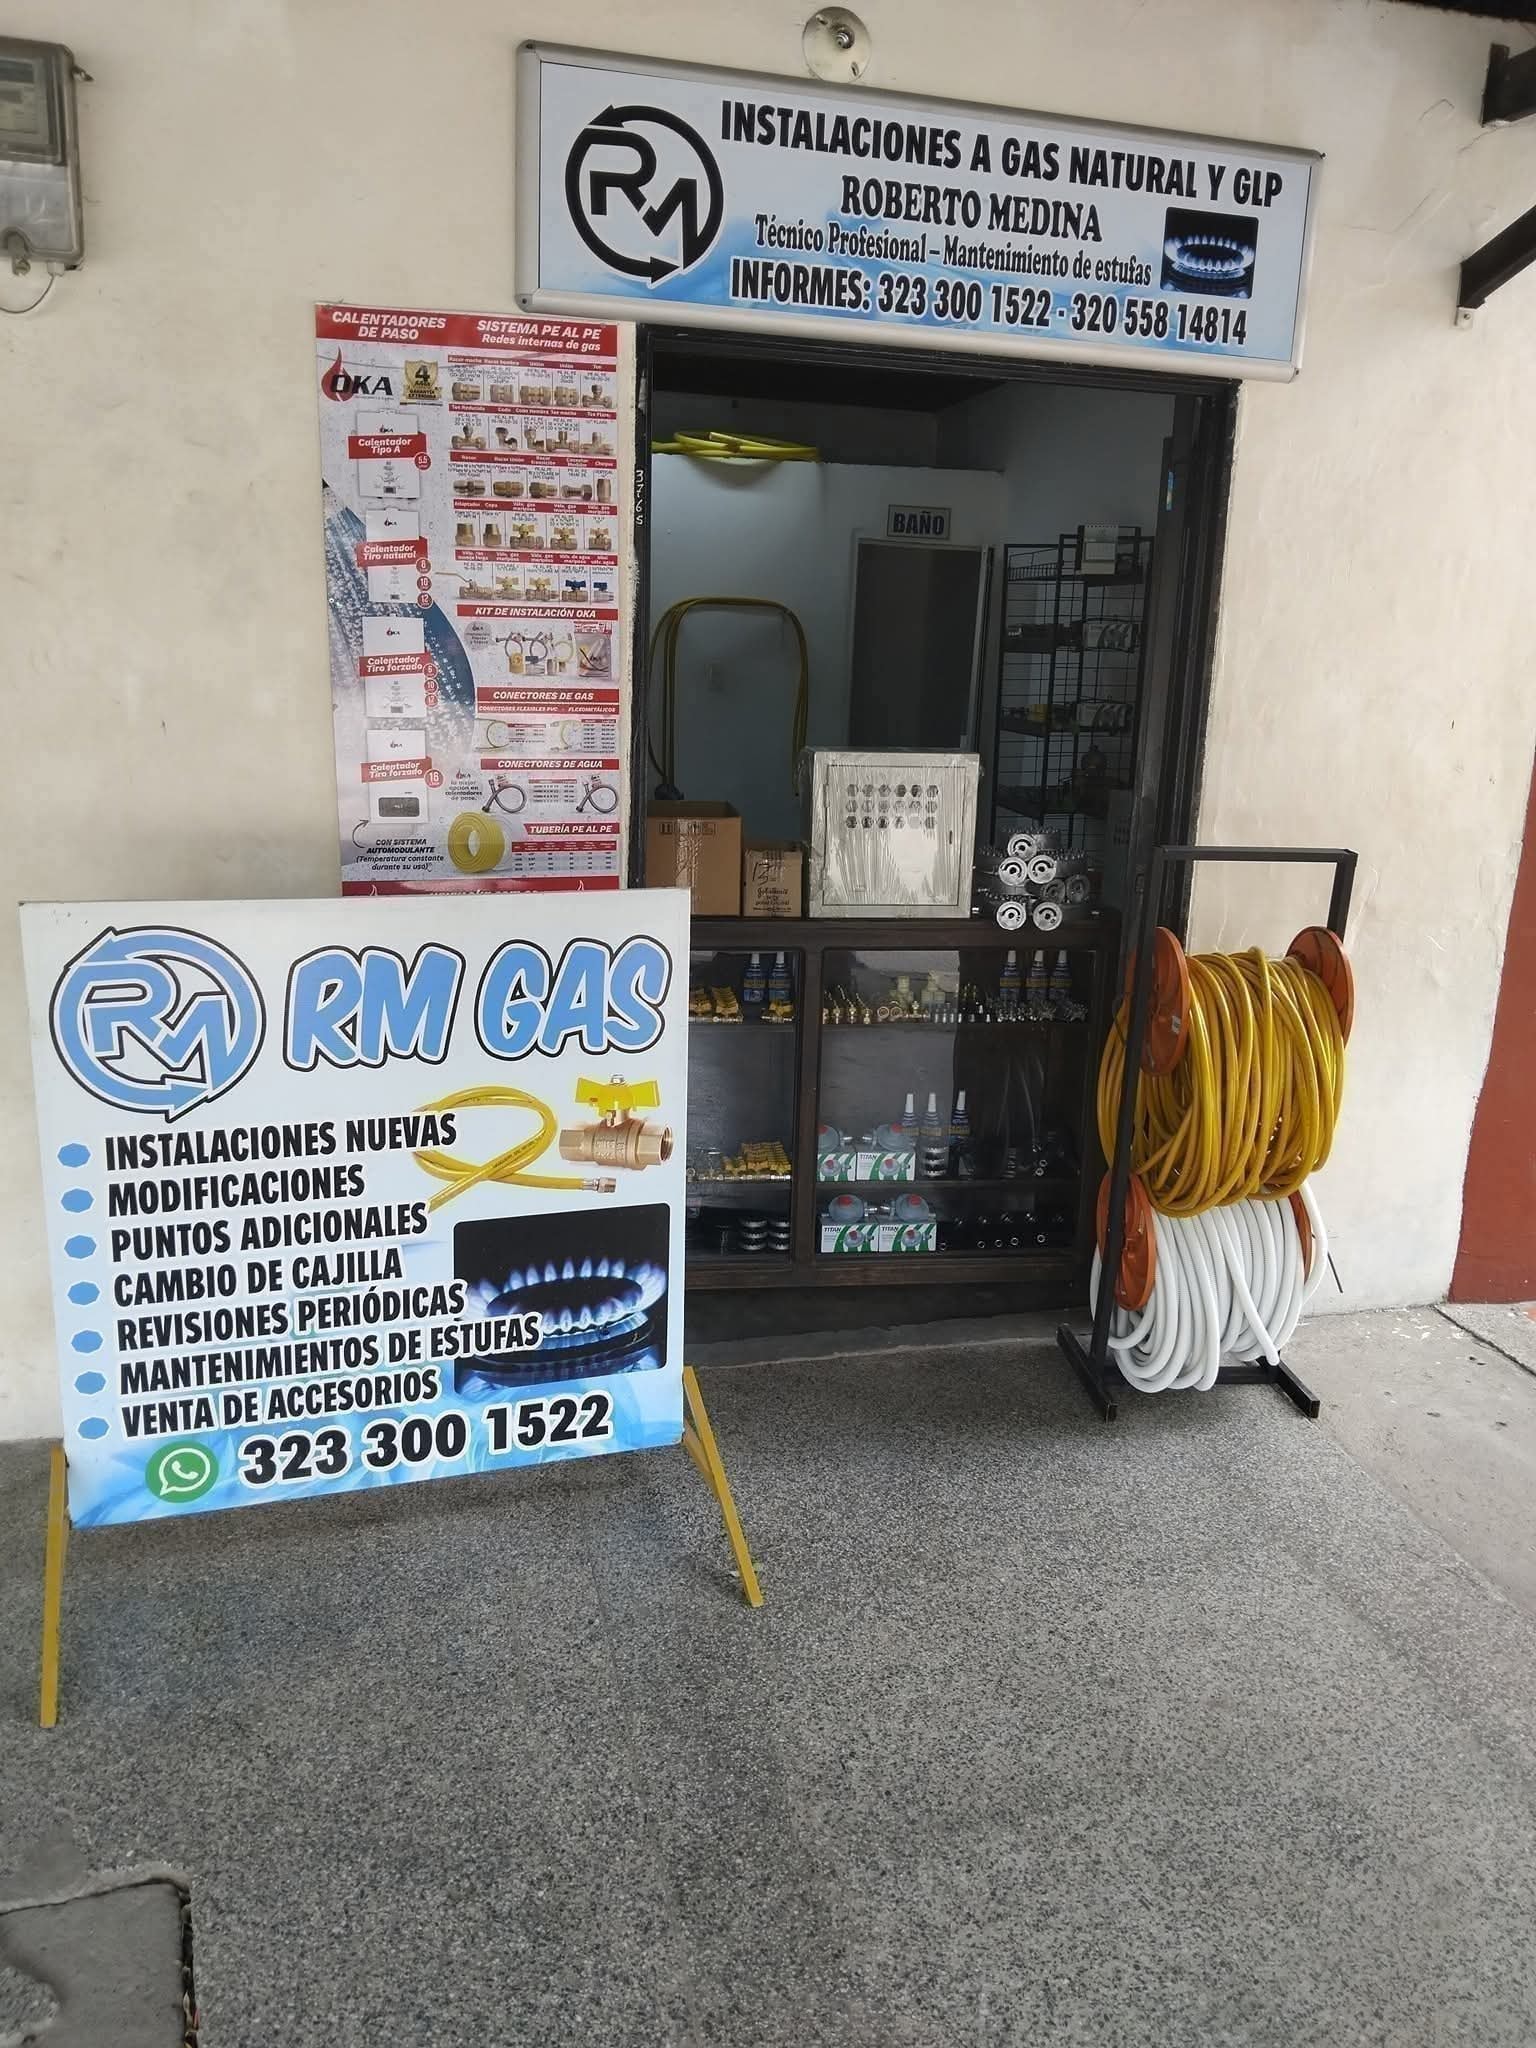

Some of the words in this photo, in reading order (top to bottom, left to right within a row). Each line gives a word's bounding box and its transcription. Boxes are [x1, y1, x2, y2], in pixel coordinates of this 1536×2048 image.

[721, 99, 961, 169] INSTALACIONES
[969, 133, 992, 173] A
[1001, 137, 1060, 181] GAS
[1069, 145, 1197, 198] NATURAL
[1207, 163, 1226, 201] Y
[1232, 167, 1283, 208] GLP
[583, 127, 698, 271] RM
[840, 174, 981, 228] ROBERTO
[987, 192, 1102, 242] MEDINA
[755, 214, 823, 252] Técnico
[827, 222, 926, 263] Profesional
[942, 233, 1069, 271] Mantenimiento
[1072, 249, 1092, 279] de
[1095, 254, 1152, 286] estufas
[731, 258, 871, 310] INFORMES:
[878, 273, 927, 316] 323
[934, 279, 982, 321] 300
[991, 285, 1051, 327] 1522
[1071, 293, 1117, 333] 320
[1124, 299, 1169, 338] 558
[1178, 303, 1247, 345] 14814
[332, 310, 446, 329] CALENTADORES
[357, 325, 380, 338] DE
[382, 327, 420, 340] PASO
[476, 320, 540, 335] SISTEMA
[541, 325, 561, 337] PE
[561, 325, 581, 338] AL
[582, 327, 602, 340] PE
[481, 333, 516, 346] Redes
[517, 336, 564, 348] internas
[565, 338, 580, 349] de
[581, 341, 601, 352] gas
[414, 364, 430, 382] 4
[358, 437, 412, 447] Calentador
[371, 446, 392, 455] Tipo
[393, 445, 401, 453] A
[893, 510, 945, 536] BAÑO
[363, 544, 415, 553] Calentador
[363, 552, 381, 560] Tiro
[383, 550, 417, 559] natural
[420, 577, 429, 586] 10
[421, 594, 429, 603] 12
[475, 607, 493, 616] KIT
[497, 608, 509, 616] DE
[509, 606, 575, 618] INSTALACIÓN
[576, 609, 596, 618] OKA
[366, 665, 385, 673] Tiro
[387, 662, 423, 672] forzado
[367, 655, 420, 665] Calentador
[493, 691, 557, 700] CONECTORES
[559, 691, 572, 700] DE
[574, 692, 594, 701] GAS
[370, 762, 420, 771] Calentador
[497, 759, 562, 769] CONECTORES
[563, 760, 577, 768] DE
[577, 759, 604, 768] AGUA
[369, 770, 387, 778] Tiro
[389, 768, 423, 777] forzado
[529, 824, 570, 834] TUBERÍA
[573, 825, 587, 833] PE
[587, 825, 599, 833] AL
[599, 825, 612, 833] PE
[366, 846, 436, 854] AUTOMODULANTE
[375, 838, 393, 846] CON
[394, 838, 427, 846] SISTEMA
[355, 855, 406, 864] (Temperatura
[371, 863, 400, 871] durante
[283, 943, 466, 1072] RM
[474, 933, 673, 1062] GAS
[105, 1120, 337, 1171] INSTALACIONES
[346, 1112, 458, 1153] NUEVAS
[108, 1163, 366, 1217] MODIFICACIONES
[111, 1219, 231, 1262] PUNTOS
[240, 1201, 428, 1251] ADICIONALES
[113, 1264, 237, 1307] CAMBIO
[247, 1260, 283, 1294] DE
[291, 1246, 403, 1289] CAJILLA
[116, 1302, 289, 1352] REVISIONES
[298, 1282, 465, 1334] PERIÓDICAS
[119, 1333, 379, 1396] MANTENIMIENTOS
[388, 1331, 422, 1364] DE
[431, 1315, 541, 1357] ESTUFAS
[121, 1396, 215, 1438] VENTA
[224, 1392, 259, 1427] DE
[266, 1368, 439, 1421] ACCESORIOS
[242, 1432, 350, 1484] 323
[366, 1414, 468, 1469] 300
[485, 1393, 612, 1450] 1522
